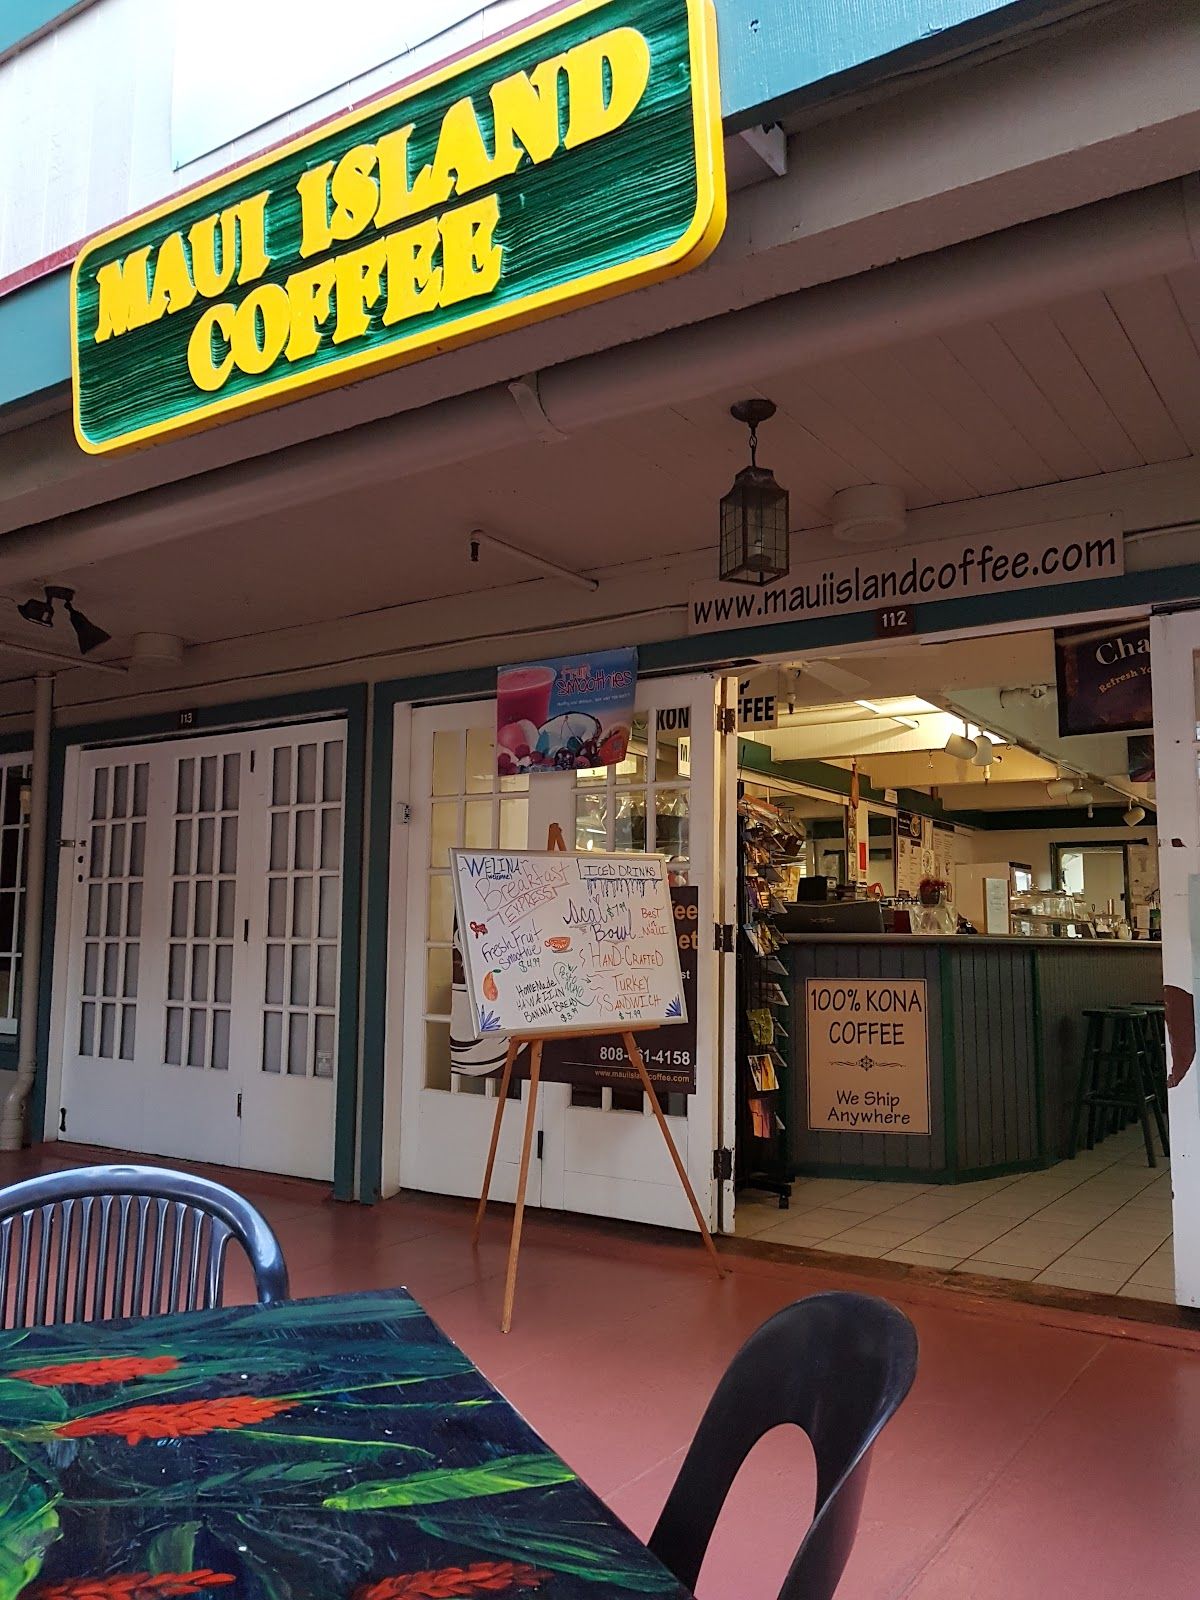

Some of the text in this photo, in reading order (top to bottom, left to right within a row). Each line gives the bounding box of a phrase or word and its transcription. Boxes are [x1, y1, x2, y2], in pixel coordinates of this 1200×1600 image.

[95, 26, 650, 343] MAUI ISLAND
[187, 194, 503, 391] COFFEE
[693, 536, 1116, 625] www.mauiislandcoffee.com
[882, 610, 908, 628] 112
[1095, 637, 1151, 665] Cha
[1098, 665, 1152, 694] Refresh Yo
[656, 705, 689, 731] KON
[460, 856, 522, 878] WELINA
[583, 863, 656, 877] ICED DRINKS
[475, 861, 569, 912] Breakfast
[504, 886, 555, 923] EXPRESS
[673, 903, 698, 920] ee
[590, 909, 637, 942] Bowl
[481, 918, 543, 963] Fresh Fruit
[678, 929, 698, 950] et
[612, 973, 650, 993] TURKEY
[602, 994, 661, 1013] SANDWICH
[811, 988, 923, 1013] 100% KONA
[523, 1004, 554, 1023] BANANA
[829, 1020, 905, 1046] COFFEE
[836, 1089, 900, 1113] We Ship
[827, 1106, 911, 1126] Anywhere
